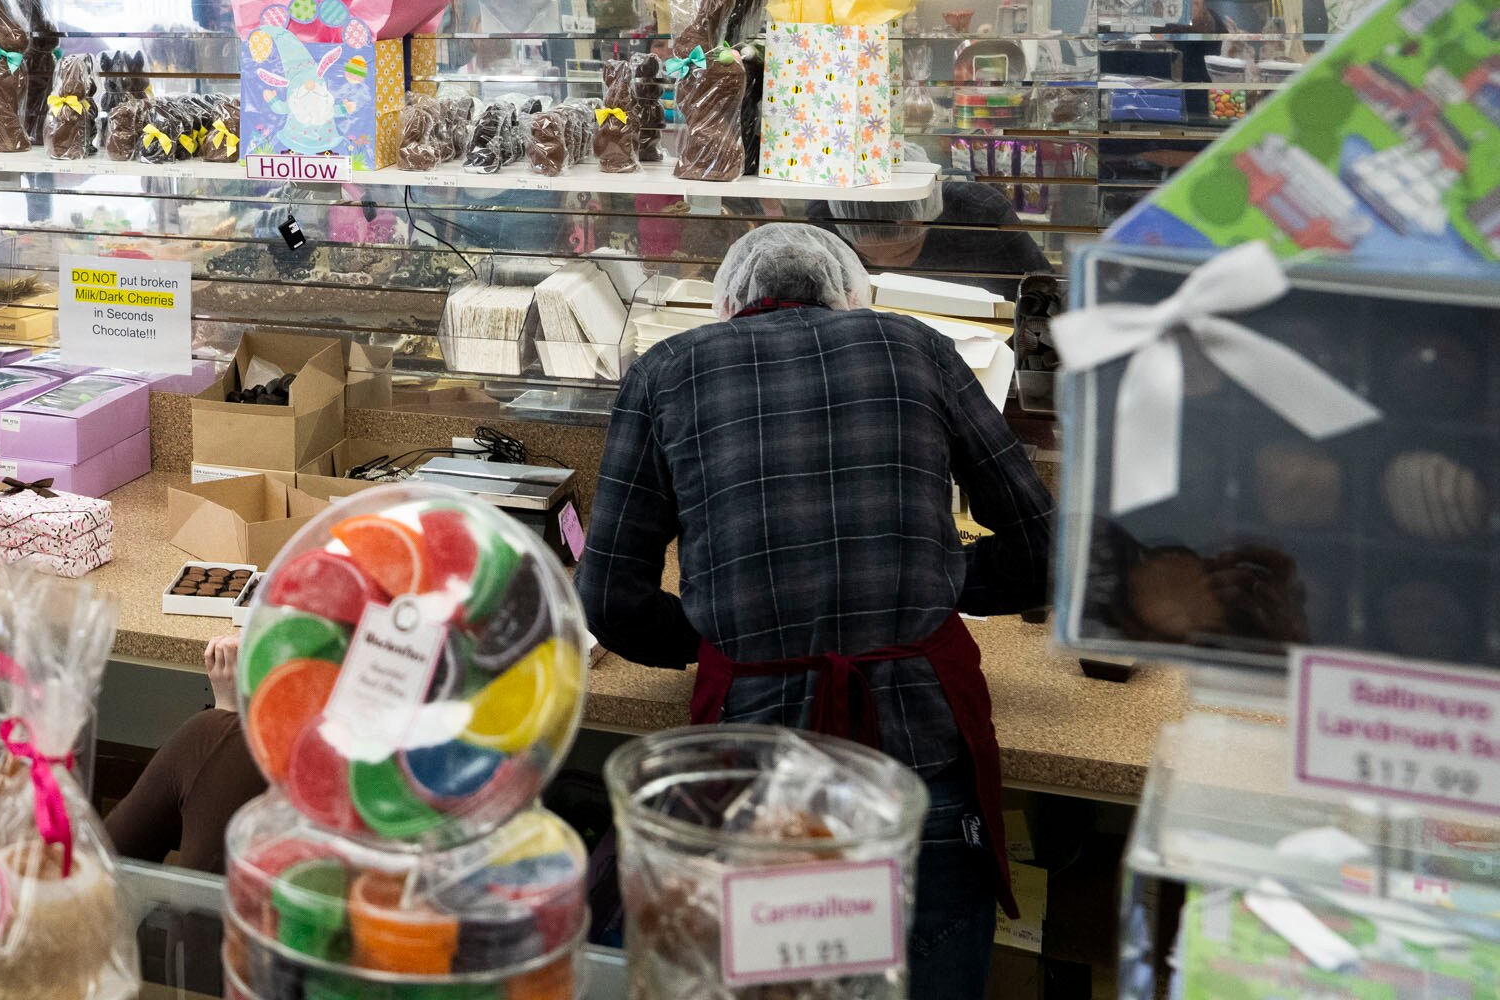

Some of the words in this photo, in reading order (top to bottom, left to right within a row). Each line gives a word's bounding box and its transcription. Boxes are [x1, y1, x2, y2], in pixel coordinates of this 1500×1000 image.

[260, 157, 338, 180] Hollow
[72, 271, 89, 282] DO
[93, 272, 117, 284] NOT
[120, 275, 138, 287] put
[141, 276, 178, 289] broken
[75, 289, 125, 303] Milk/Dark
[128, 292, 174, 306] Cherries
[94, 307, 103, 318] in
[107, 308, 154, 322] Seconds
[92, 324, 156, 340] Chocolate!!!
[1351, 678, 1495, 722] Baltimore
[1316, 714, 1458, 757] Landmark
